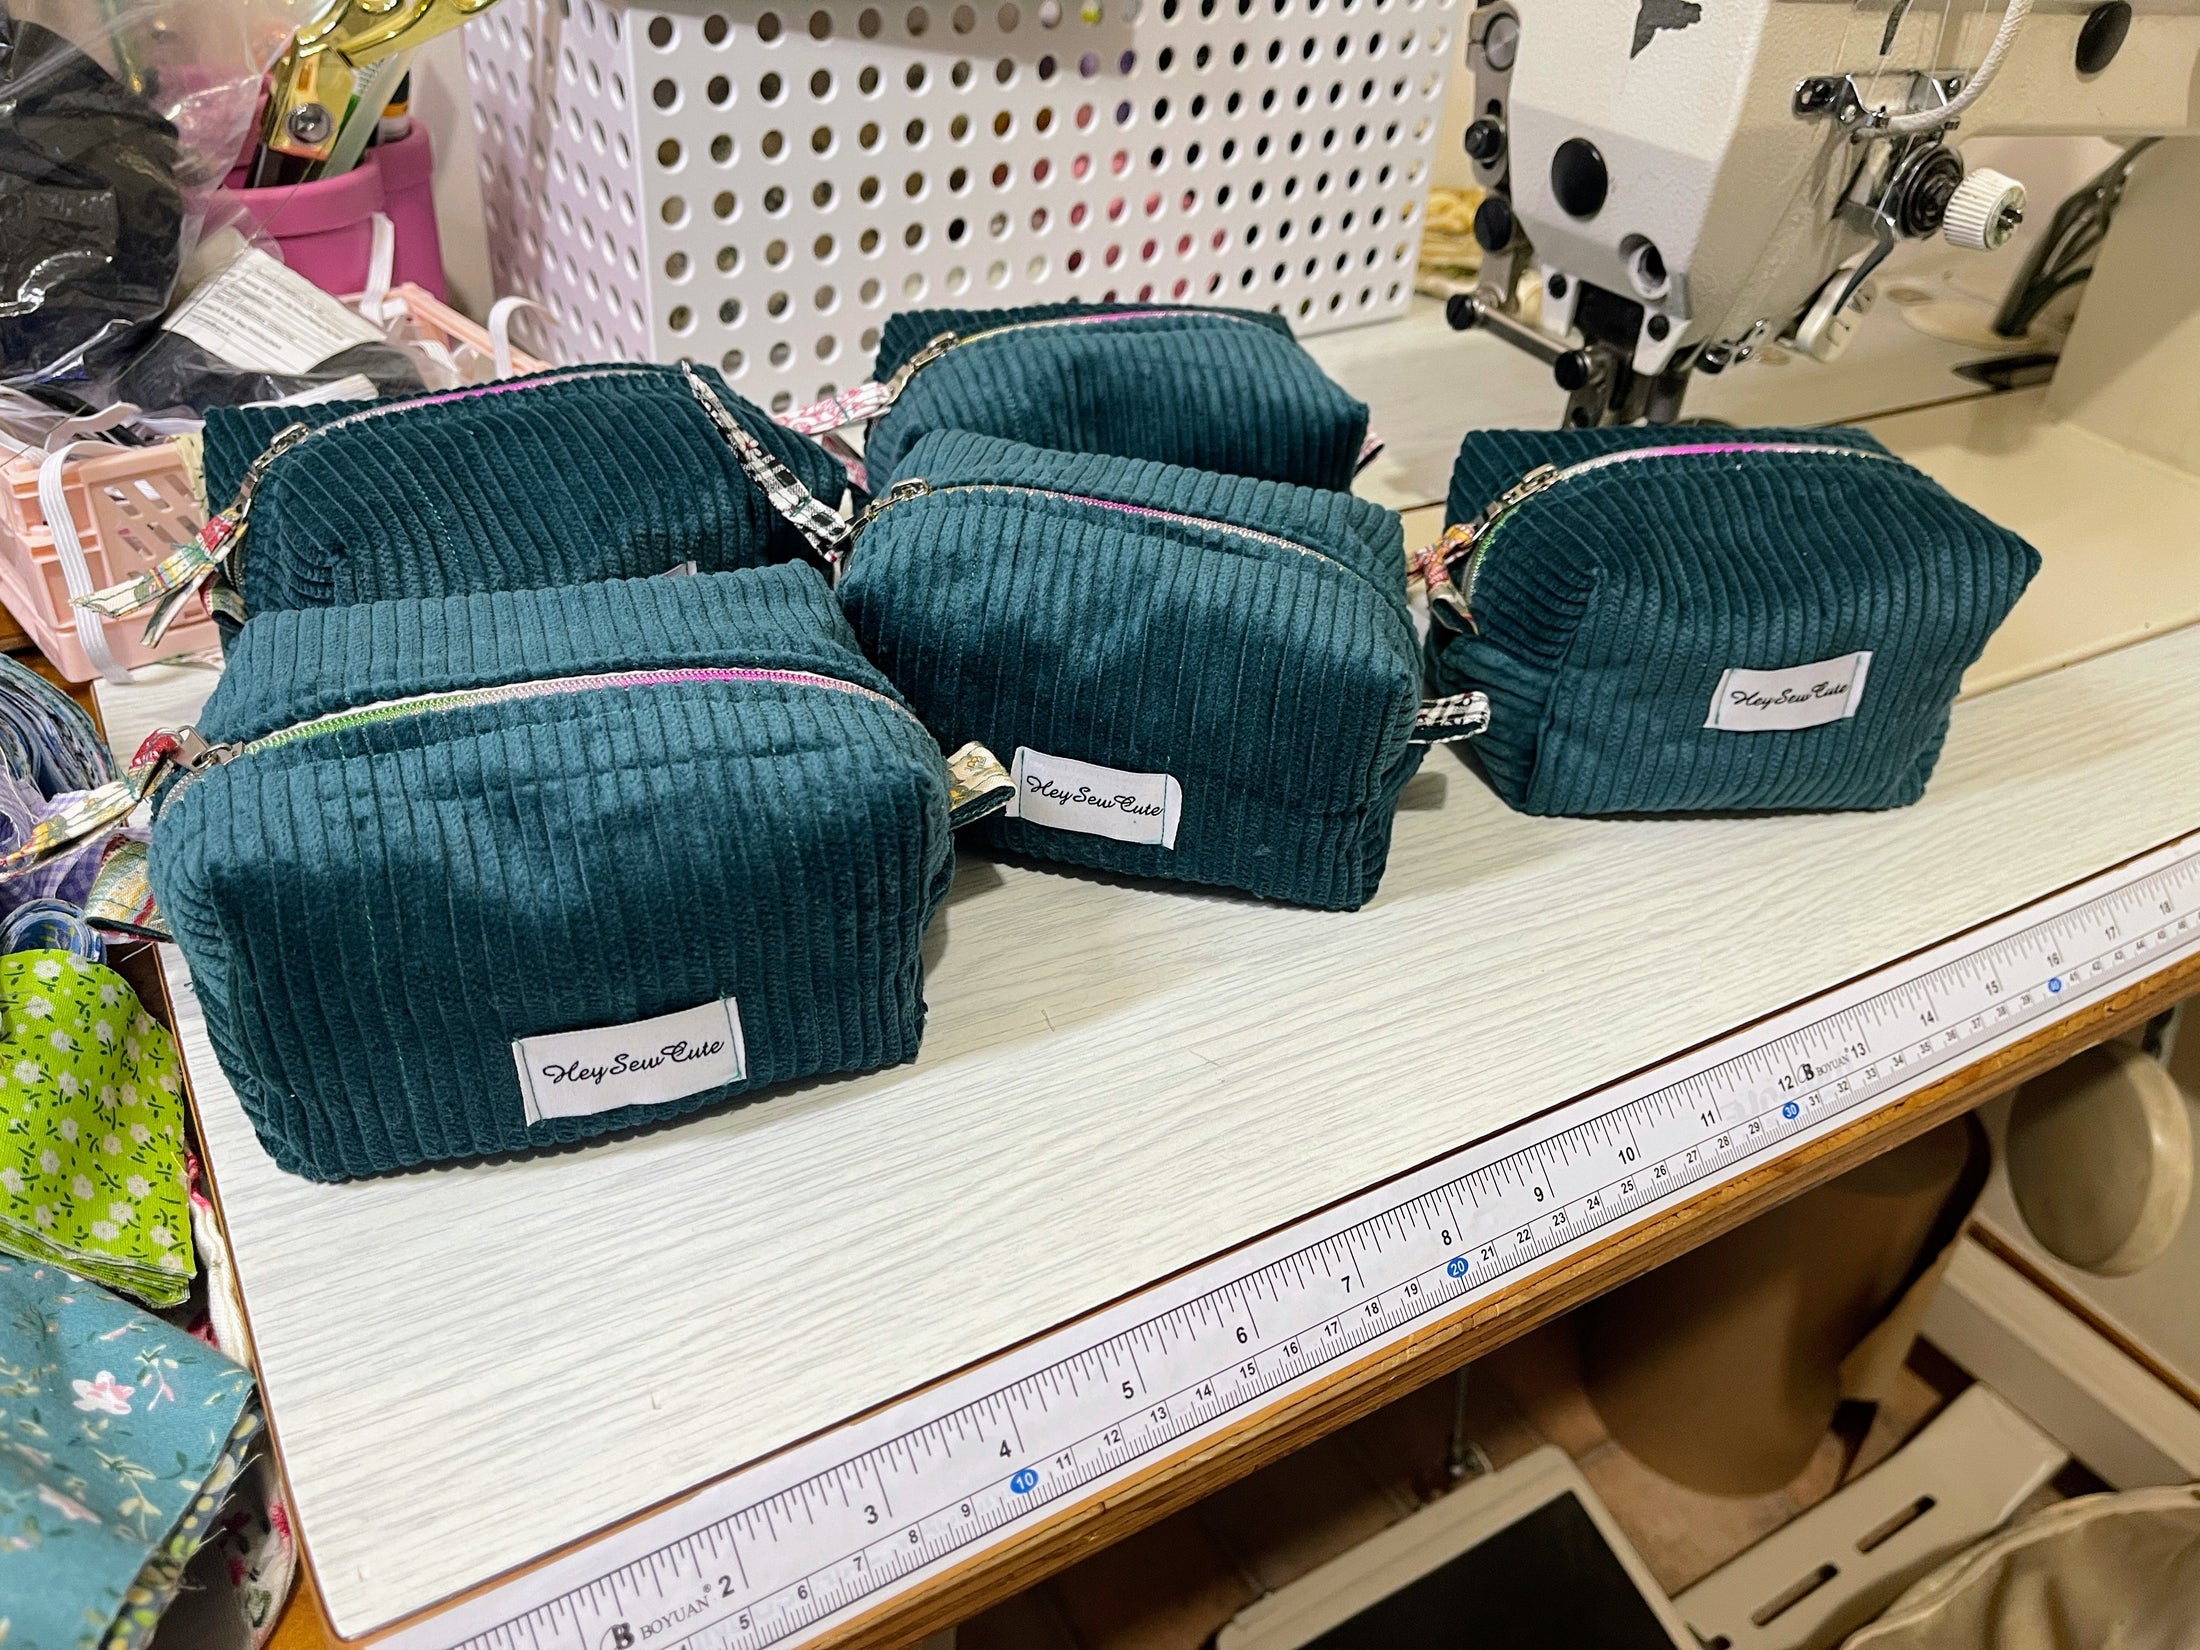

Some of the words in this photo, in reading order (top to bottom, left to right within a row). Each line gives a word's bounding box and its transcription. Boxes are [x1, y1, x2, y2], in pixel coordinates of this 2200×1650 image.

[717, 1574, 736, 1598] 2
[863, 1504, 880, 1524] 3
[999, 1439, 1012, 1459] 4
[1121, 1381, 1135, 1399] 5
[1235, 1326, 1248, 1345] 6
[1341, 1276, 1351, 1294] 7
[1441, 1229, 1452, 1246] 8
[1533, 1186, 1544, 1203] 9
[1617, 1146, 1635, 1165] 10
[1701, 1109, 1716, 1128] 11
[1777, 1075, 1795, 1093] 12
[1851, 1042, 1867, 1059] 13
[1920, 1011, 1935, 1026] 14
[1985, 981, 2000, 996] 15
[2047, 953, 2060, 968] 16
[2105, 926, 2117, 941] 17
[739, 1614, 751, 1630] 5
[796, 1584, 808, 1600] 6
[853, 1556, 863, 1572] 7
[908, 1530, 919, 1544] 8
[961, 1504, 972, 1518] 9
[1016, 1474, 1035, 1490] 10
[1056, 1452, 1072, 1470] 11
[1103, 1429, 1121, 1445] 12
[1150, 1406, 1168, 1423] 13
[1196, 1384, 1212, 1401] 14
[1240, 1363, 1256, 1380] 15
[1283, 1341, 1299, 1357] 16
[1325, 1321, 1338, 1338] 17
[1365, 1302, 1379, 1317] 18
[1404, 1282, 1419, 1297] 19
[1451, 1261, 1465, 1276] 20
[1481, 1246, 1495, 1261] 21
[1517, 1230, 1531, 1244] 22
[1552, 1212, 1566, 1227] 23
[1587, 1196, 1601, 1210] 24
[1621, 1180, 1634, 1195] 25
[1653, 1164, 1667, 1179] 26
[1686, 1149, 1698, 1164] 27
[1717, 1135, 1730, 1150] 28
[1748, 1122, 1761, 1135] 29
[1784, 1104, 1798, 1117] 30
[1809, 1094, 1820, 1107] 31
[1837, 1079, 1849, 1093] 32
[1865, 1067, 1877, 1080] 33
[1893, 1055, 1904, 1067] 34
[1920, 1042, 1931, 1055] 35
